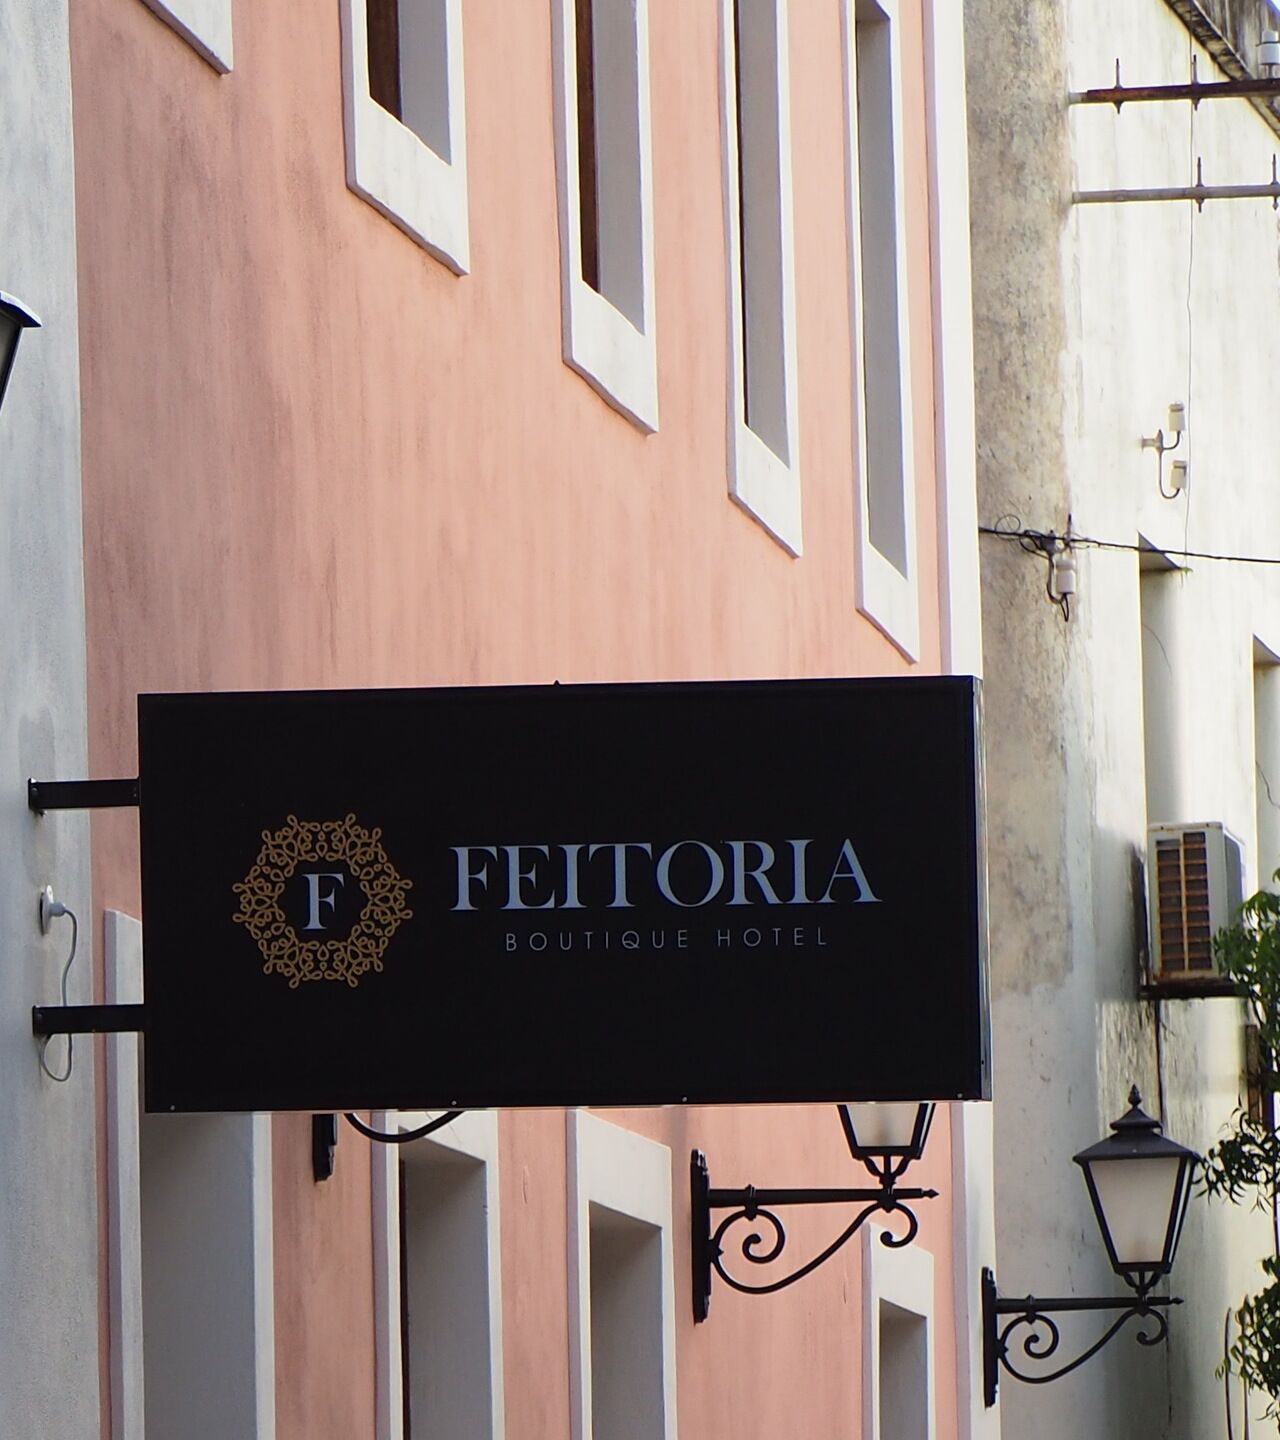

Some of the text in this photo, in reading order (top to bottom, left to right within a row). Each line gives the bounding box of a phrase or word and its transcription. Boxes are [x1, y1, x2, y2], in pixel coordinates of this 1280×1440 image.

[302, 873, 345, 930] F
[450, 838, 882, 911] FEITORIA
[505, 926, 827, 952] BOUTIQUE HOTEL
